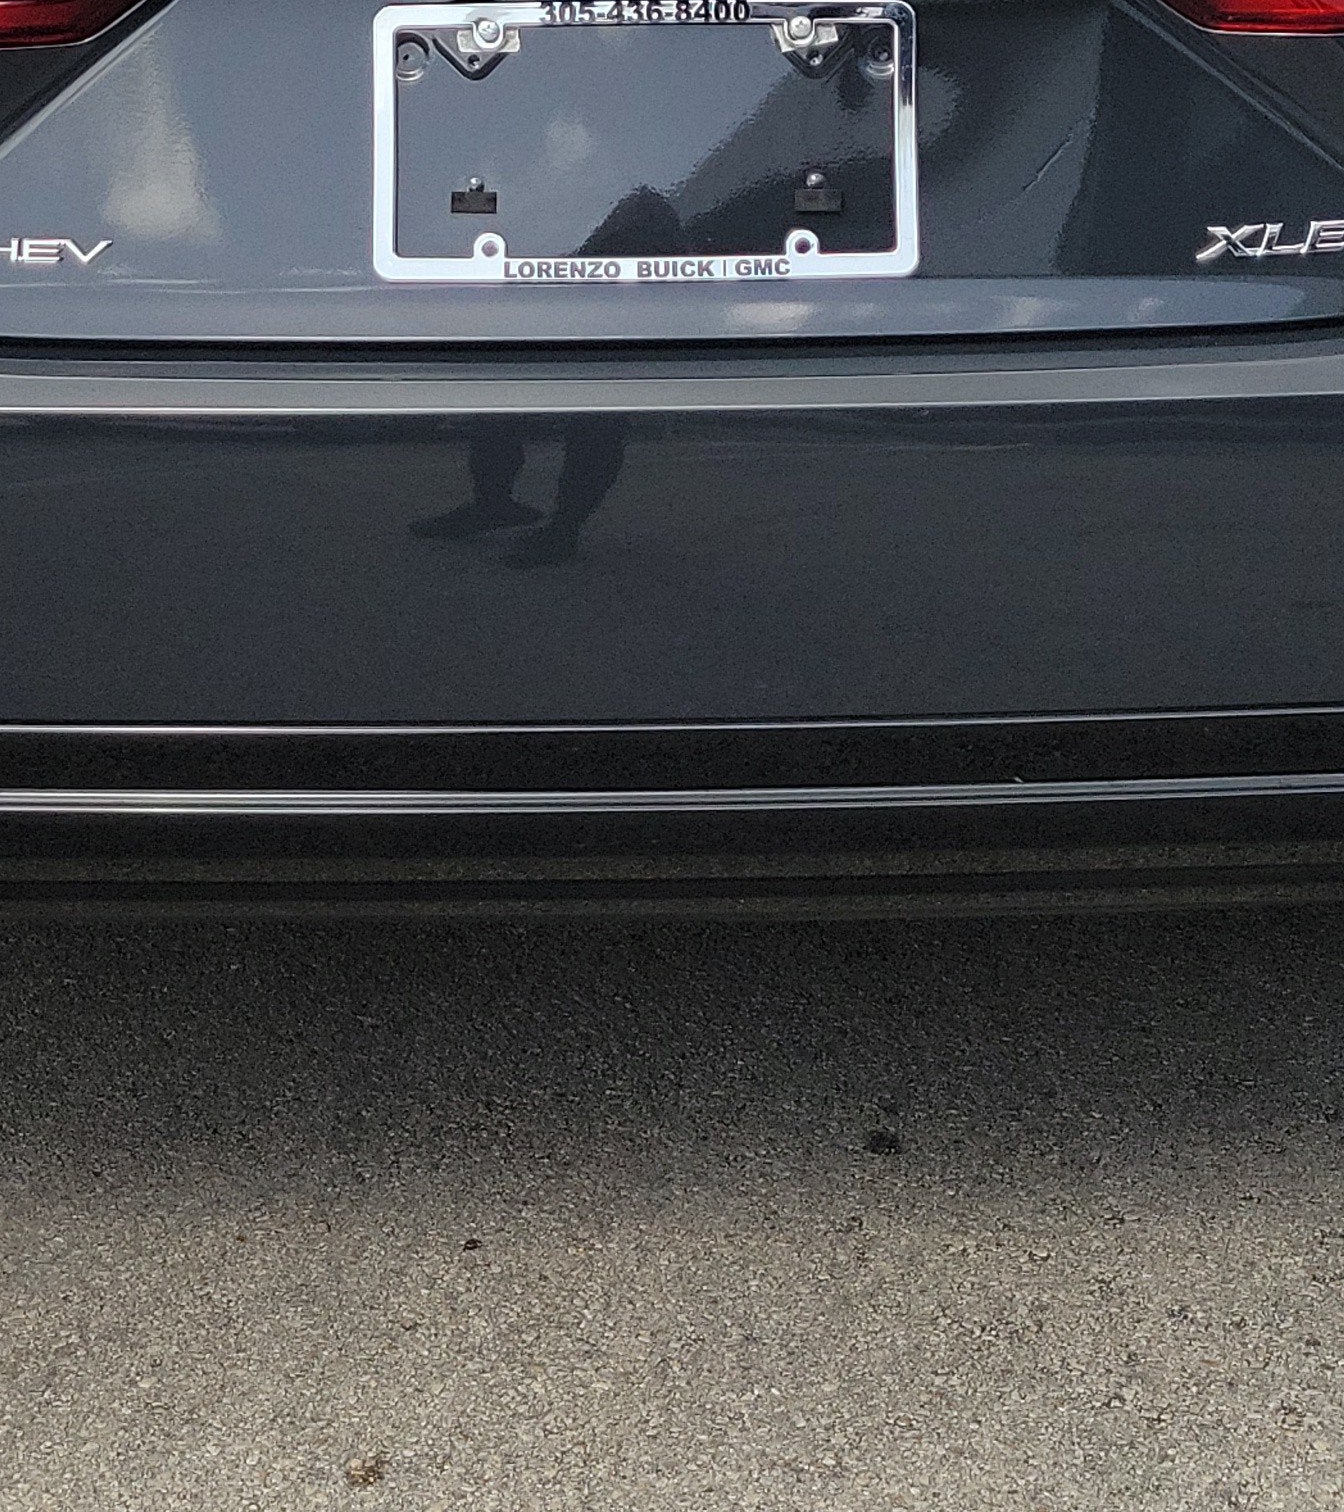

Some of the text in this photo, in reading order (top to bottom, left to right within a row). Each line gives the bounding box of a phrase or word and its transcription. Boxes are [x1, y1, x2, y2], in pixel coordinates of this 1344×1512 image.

[538, 0, 752, 24] 305-436-8400
[504, 258, 791, 279] LORENZO BUICK GMC
